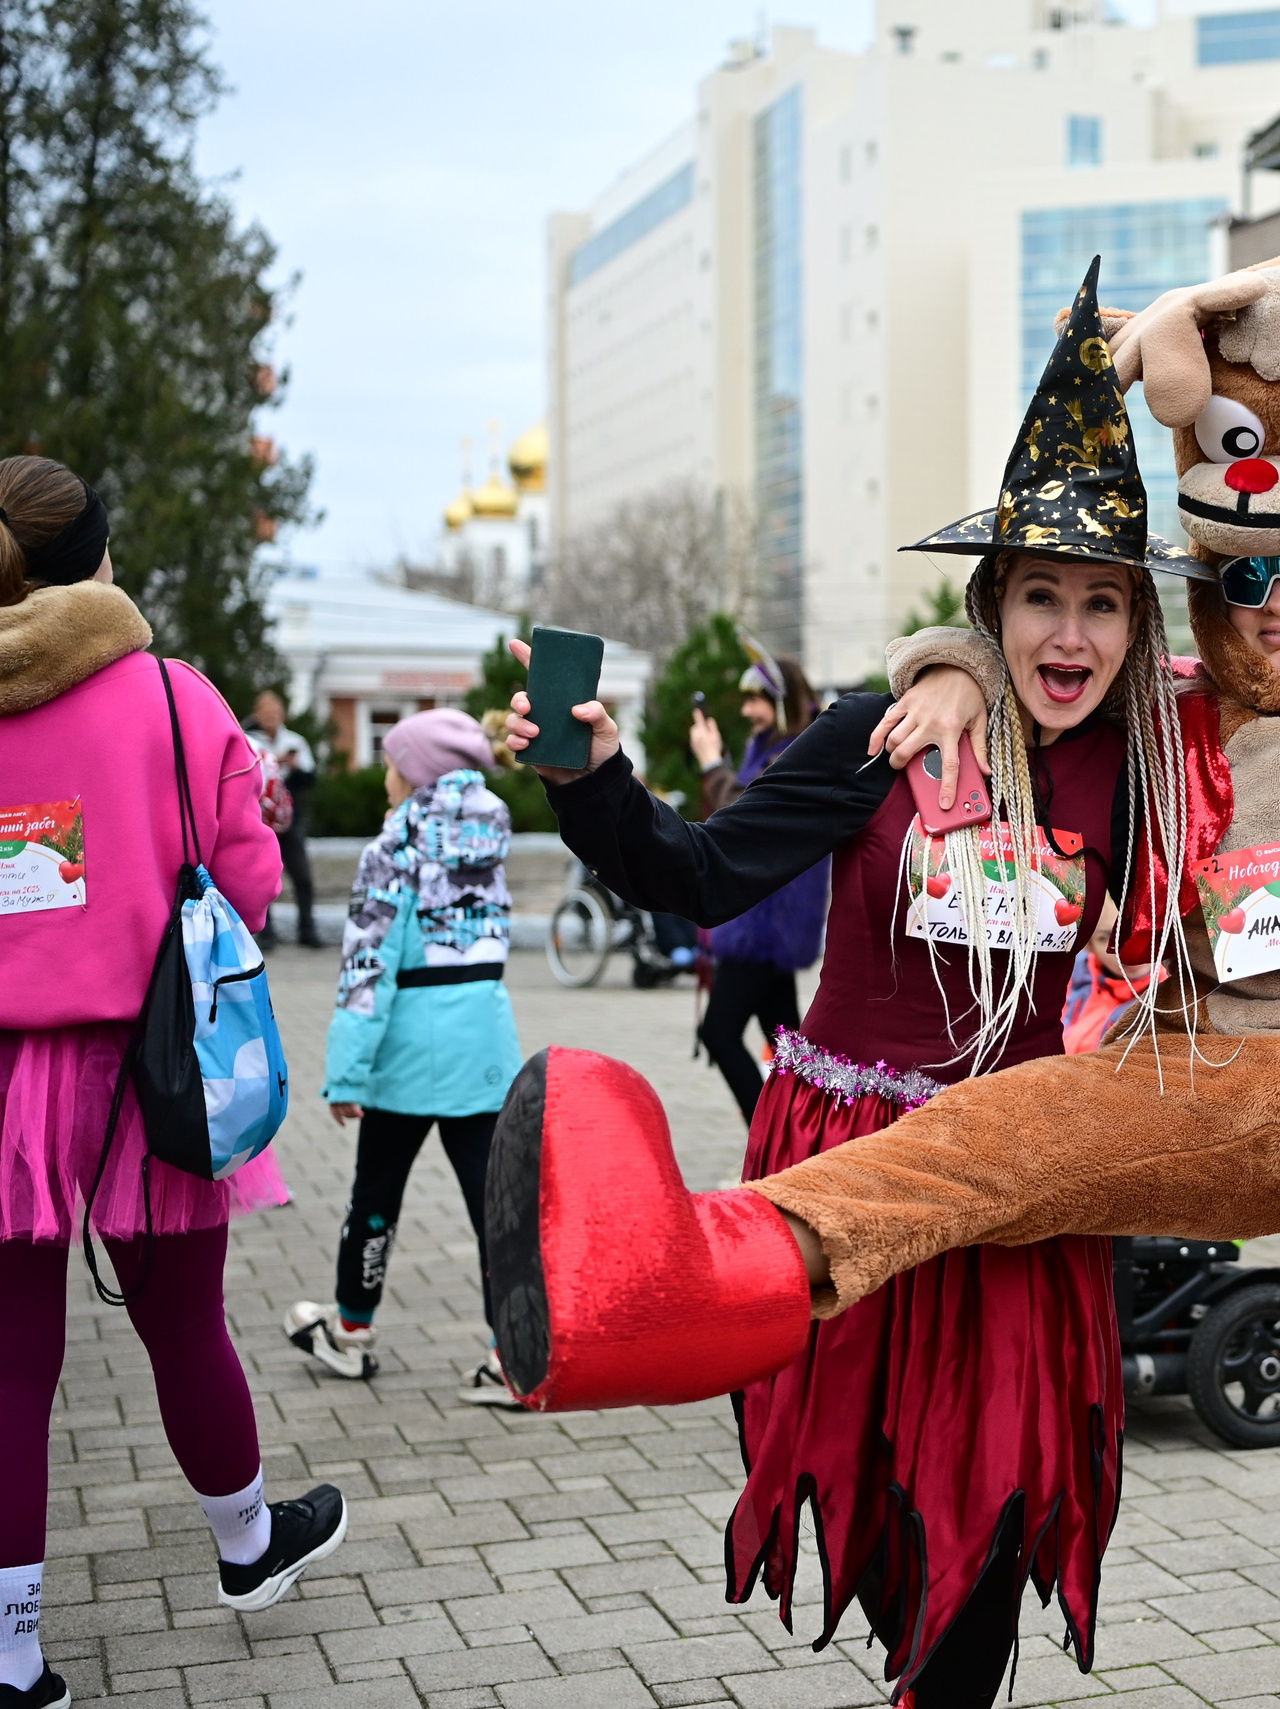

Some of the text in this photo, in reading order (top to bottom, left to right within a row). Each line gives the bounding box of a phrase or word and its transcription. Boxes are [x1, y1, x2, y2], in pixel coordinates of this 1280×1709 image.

[24, 816, 56, 837] забег
[1211, 859, 1224, 874] 2
[928, 922, 992, 941] ТОЛЬО
[28, 1582, 40, 1596] ЗА
